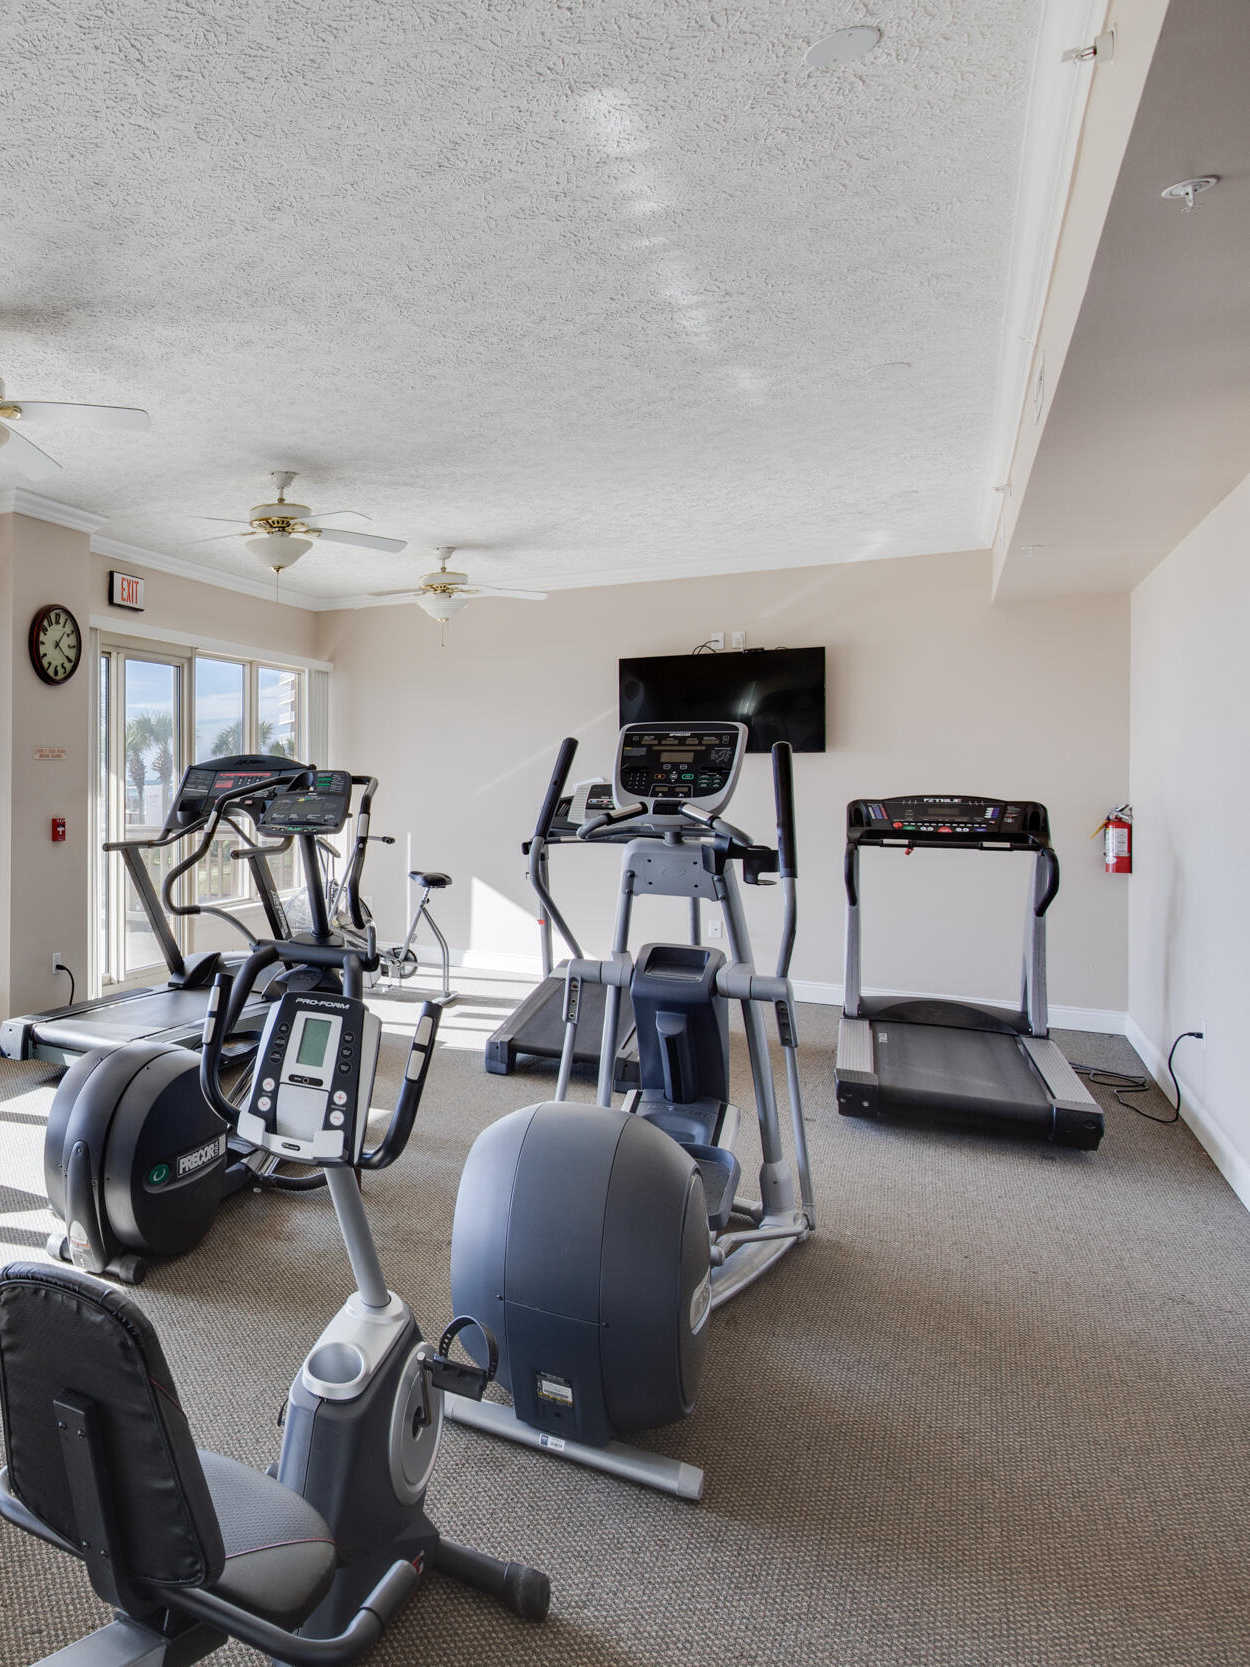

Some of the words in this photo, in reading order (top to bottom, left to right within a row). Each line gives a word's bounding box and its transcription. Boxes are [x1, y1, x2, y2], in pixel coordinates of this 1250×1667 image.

[120, 577, 140, 605] EXIT
[295, 997, 350, 1010] PRO-FORM
[179, 1143, 215, 1175] PRECOR
